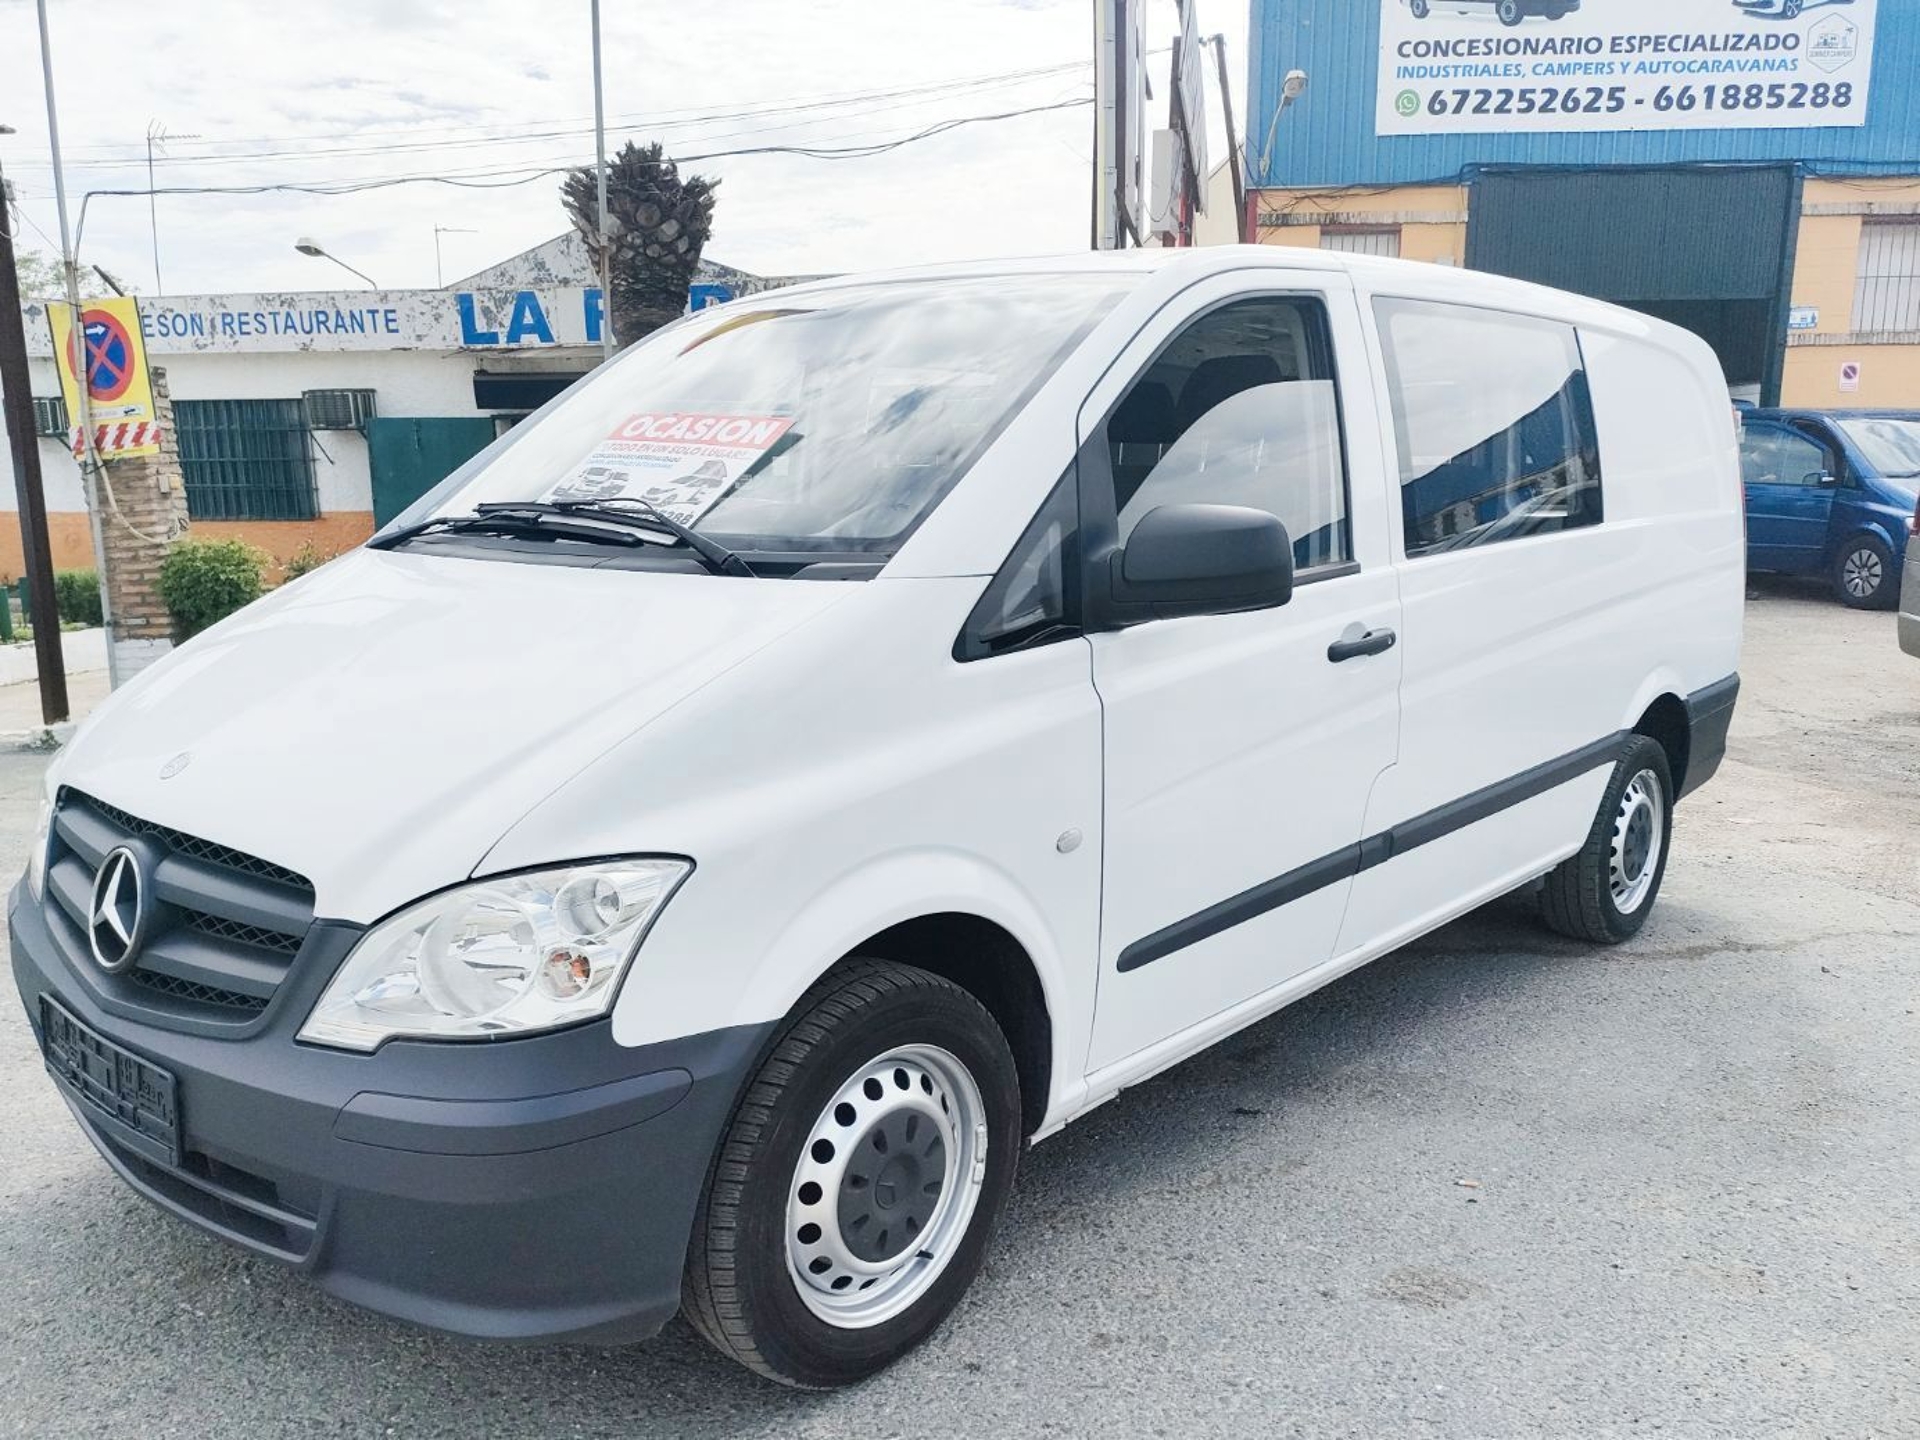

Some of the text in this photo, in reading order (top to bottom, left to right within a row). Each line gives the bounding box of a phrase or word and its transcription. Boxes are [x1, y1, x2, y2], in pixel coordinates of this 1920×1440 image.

[1396, 36, 1603, 58] CONCESIONARIO
[1609, 33, 1801, 54] ESPECIALIZADO
[1396, 57, 1799, 80] INDUSTRIALES, CAMPERS Y AUTOCARAVANAS
[1427, 86, 1627, 116] 672252625
[1653, 82, 1853, 112] 661885288
[141, 309, 400, 338] ESON RESTAURANTE
[455, 290, 556, 345] LA
[621, 415, 779, 445] OCASION
